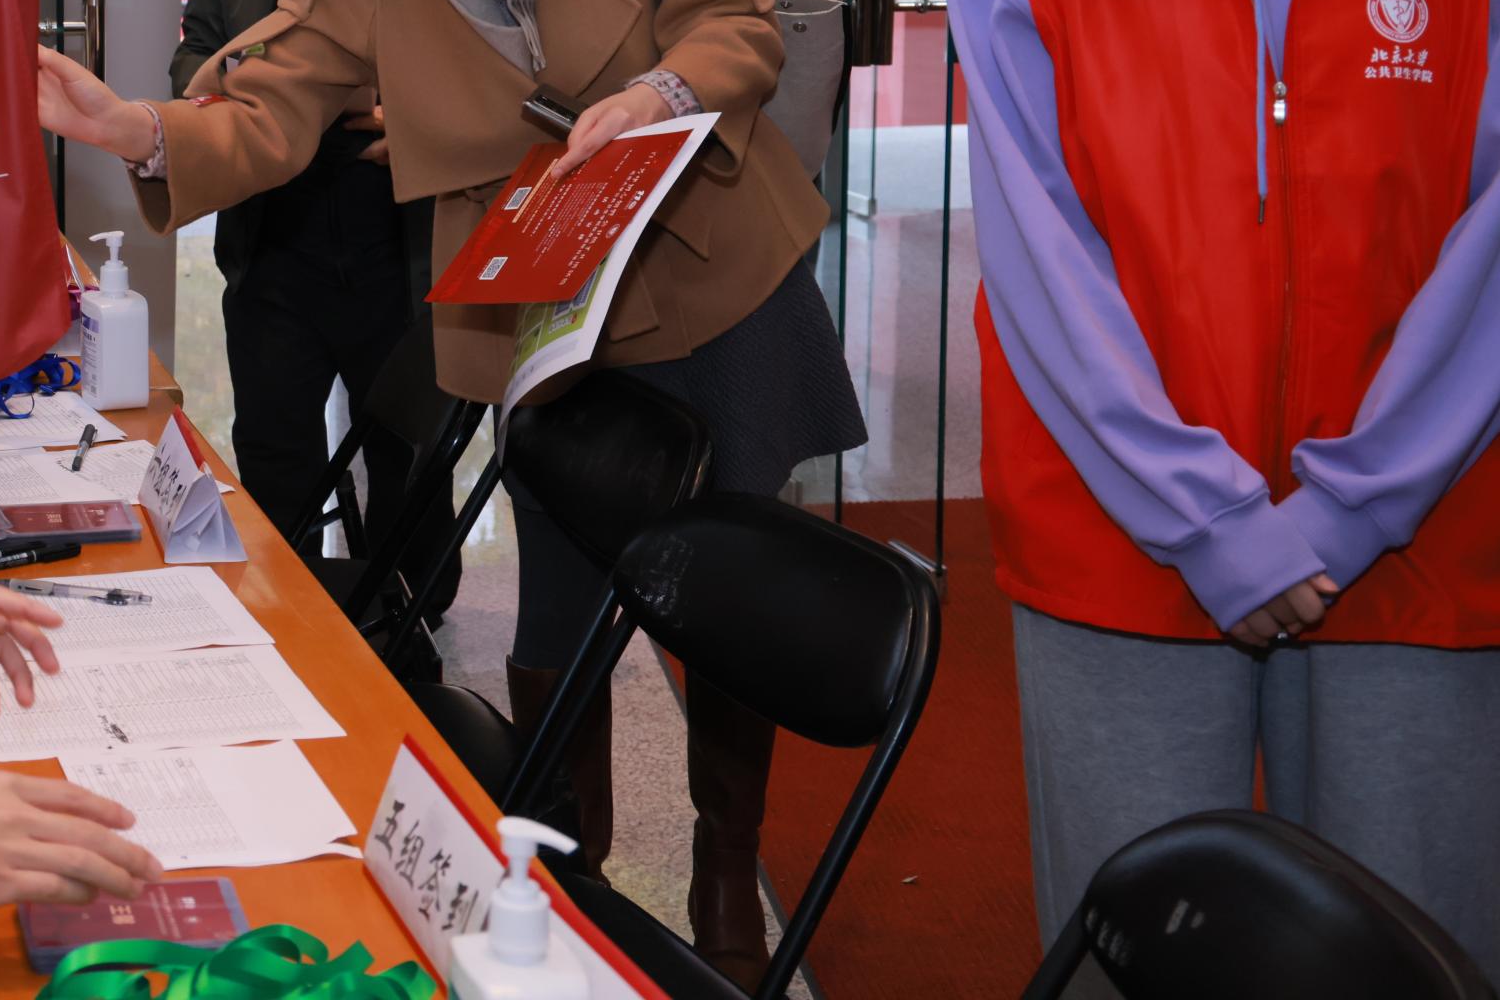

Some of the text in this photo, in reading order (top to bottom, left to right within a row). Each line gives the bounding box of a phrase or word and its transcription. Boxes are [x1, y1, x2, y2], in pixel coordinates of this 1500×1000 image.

[1370, 45, 1429, 67] 北京大学
[1365, 66, 1433, 83] 公共卫生学院
